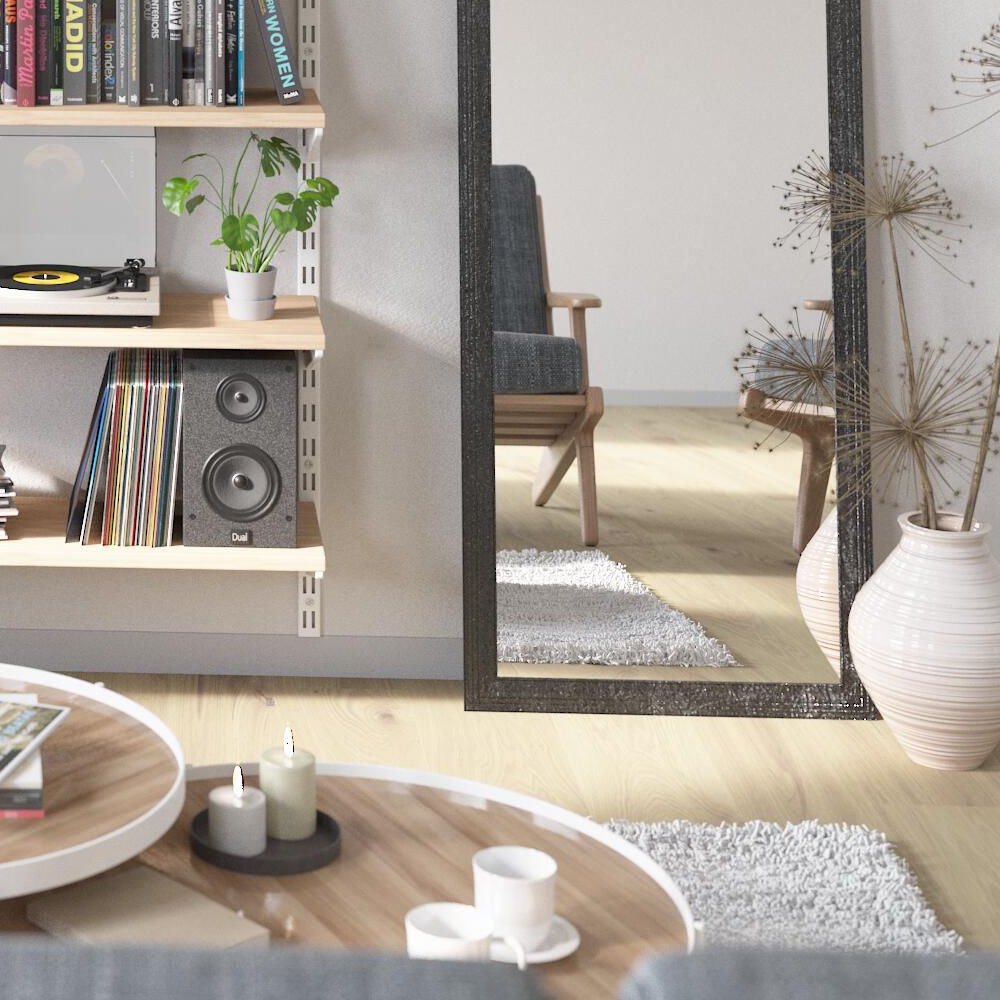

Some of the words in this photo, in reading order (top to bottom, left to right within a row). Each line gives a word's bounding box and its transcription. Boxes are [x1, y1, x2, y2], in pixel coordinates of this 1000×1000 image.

[18, 24, 34, 86] Martin
[265, 15, 296, 88] WOMEN
[231, 532, 248, 542] Dual
